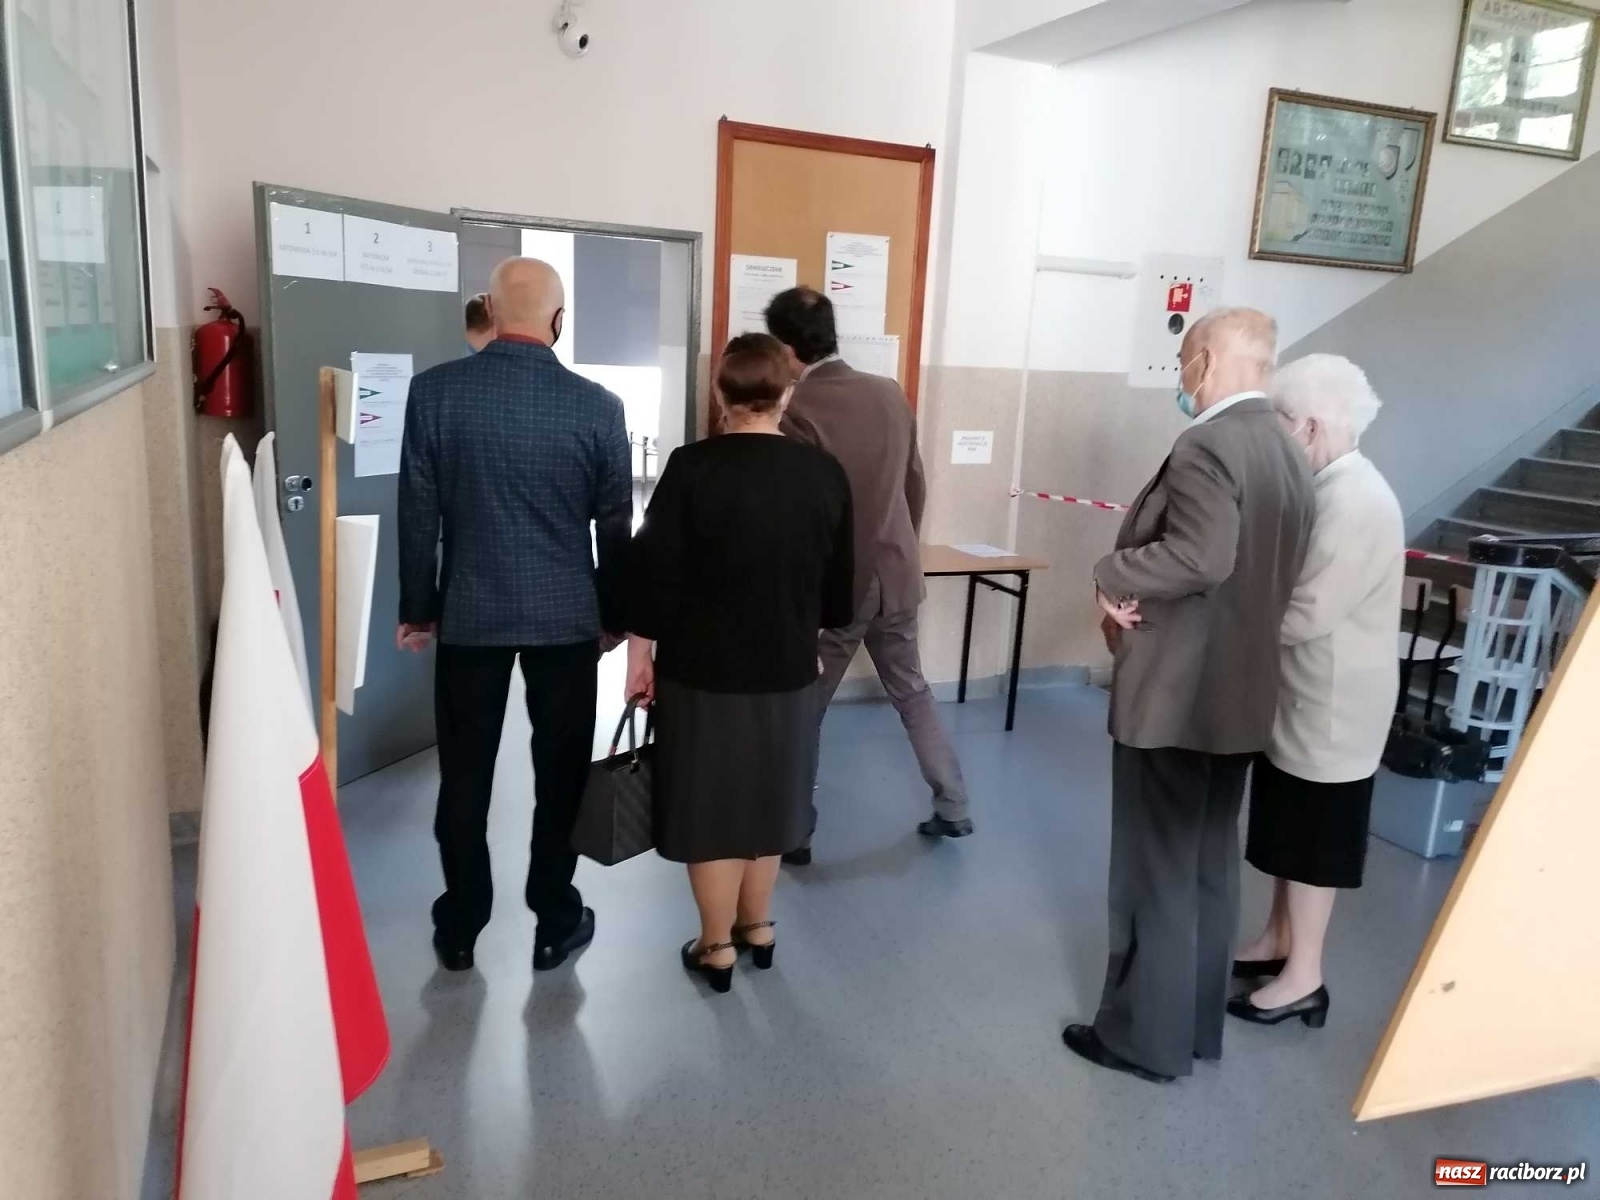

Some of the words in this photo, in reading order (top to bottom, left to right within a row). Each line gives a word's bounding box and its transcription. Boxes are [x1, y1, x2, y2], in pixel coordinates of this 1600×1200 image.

[305, 222, 311, 235] 1
[373, 232, 380, 244] 2
[427, 241, 433, 252] 3
